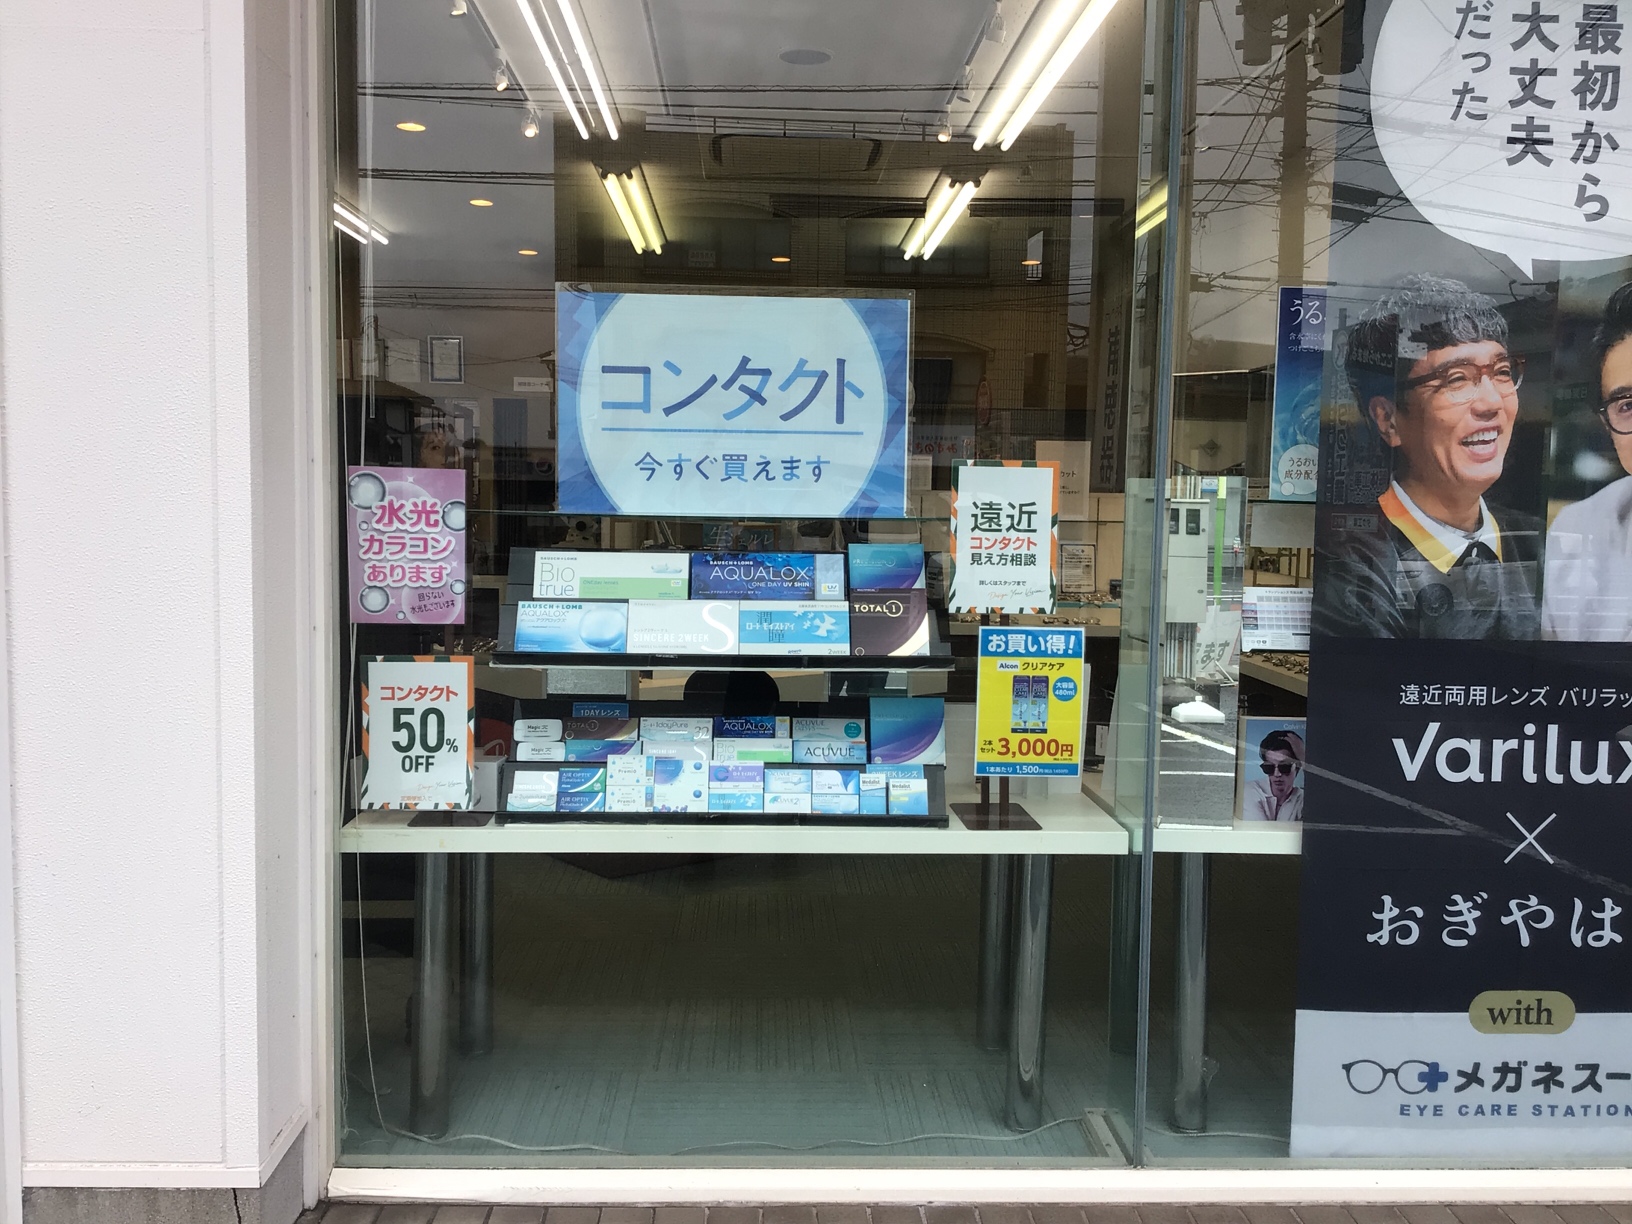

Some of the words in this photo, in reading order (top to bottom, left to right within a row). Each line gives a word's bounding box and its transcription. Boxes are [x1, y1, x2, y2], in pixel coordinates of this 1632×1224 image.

[1449, 0, 1494, 122] だった
[1506, 1, 1560, 168] 大丈夫
[1570, 3, 1624, 223] 最初から
[1289, 299, 1327, 325] うる
[601, 355, 864, 425] コンタクト
[634, 451, 831, 483] 今すぐ買えます
[374, 498, 441, 529] 水光
[970, 500, 1038, 533] 遠近
[361, 533, 454, 557] カラコン
[970, 536, 1038, 552] コンタクト
[969, 553, 1037, 567] 見え方相談
[366, 563, 449, 584] あります
[710, 566, 810, 581] AQUALOX
[979, 579, 1027, 587] 詳しくはスタッフまで
[417, 592, 445, 602] 回らない
[520, 609, 567, 618] AQUALOX
[853, 604, 889, 613] TOTAL
[633, 633, 675, 643] SINCERE
[677, 633, 710, 643] 2WEEK
[987, 633, 1078, 655] お買い得!
[998, 662, 1019, 670] Alcon
[1021, 662, 1066, 671] クリアケア
[380, 685, 459, 702] コンタクト
[1399, 683, 1551, 707] 遠近両用レンズ
[1558, 686, 1632, 709] バリラッ
[391, 706, 460, 754] 50%
[723, 722, 773, 731] AQUALOX
[804, 746, 856, 758] ACUVUE
[980, 746, 996, 754] セット
[982, 739, 994, 747] 2本
[996, 737, 1074, 758] 3,000円
[401, 754, 436, 773] OFF
[1366, 891, 1623, 948] おぎやは
[1486, 998, 1554, 1026] with
[1453, 1060, 1632, 1094] メガネスー
[1399, 1104, 1444, 1117] EYE
[1457, 1104, 1518, 1117] CARE
